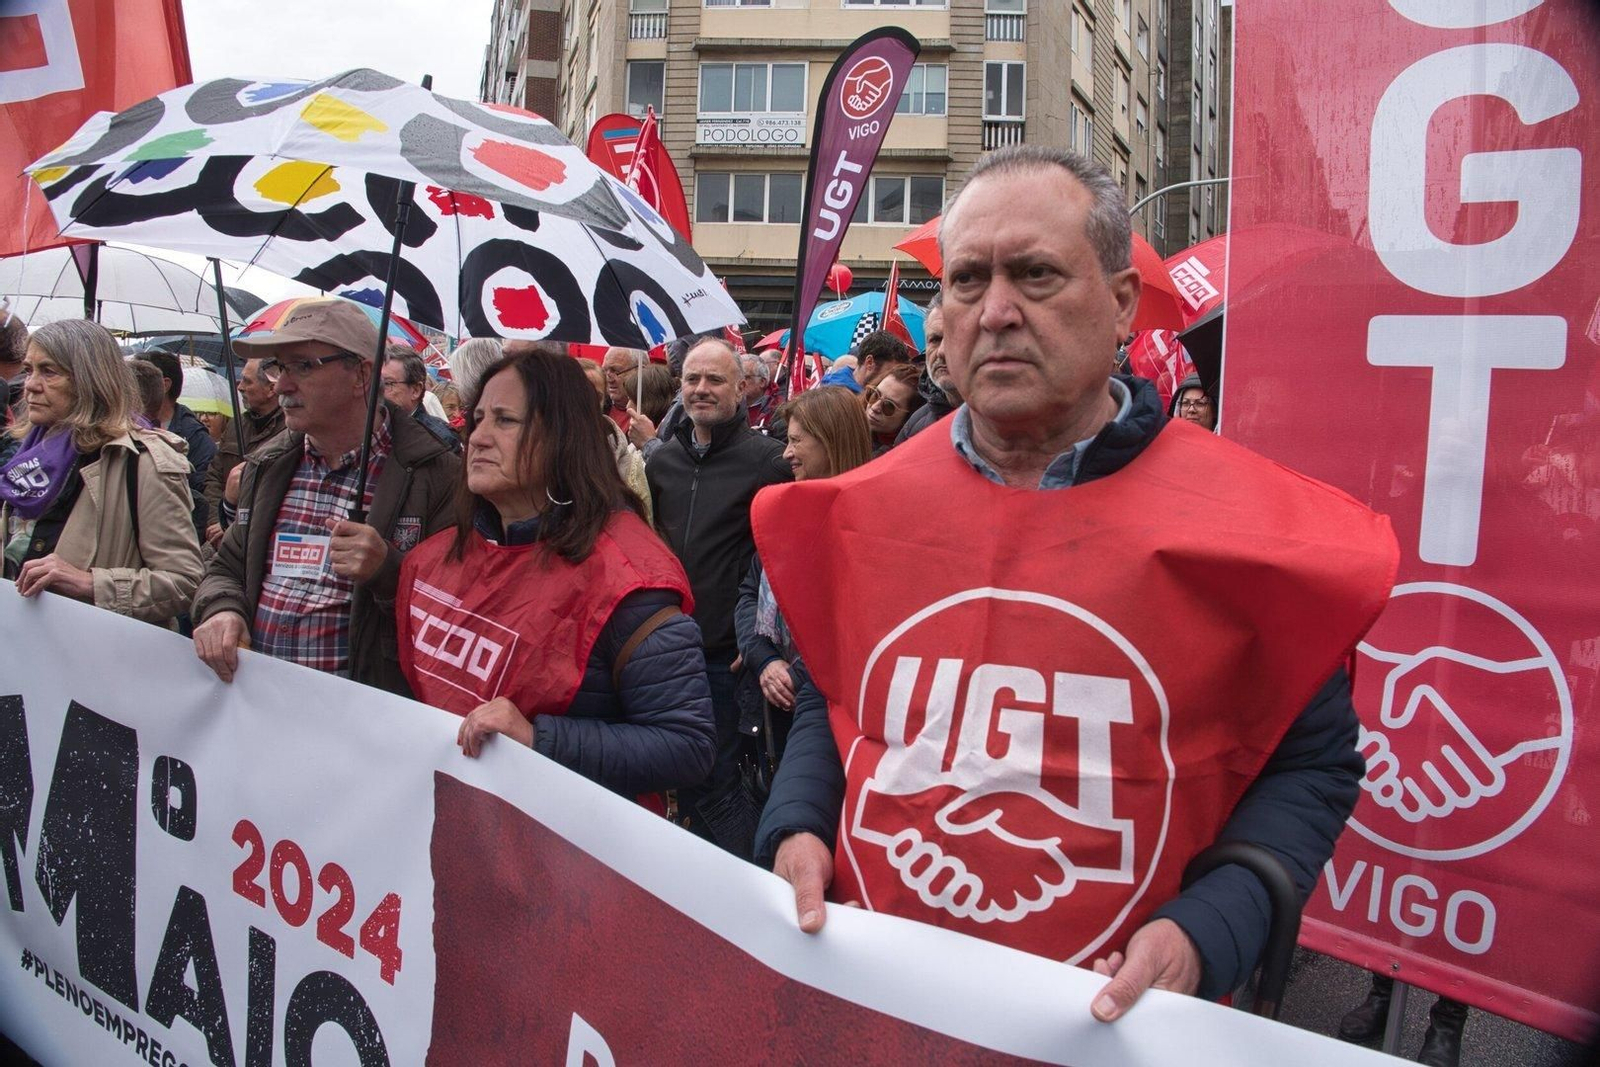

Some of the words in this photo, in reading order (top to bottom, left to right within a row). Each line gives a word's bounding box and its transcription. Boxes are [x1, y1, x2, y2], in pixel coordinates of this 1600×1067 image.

[703, 128, 798, 142] PODOLOGO
[848, 120, 880, 140] VIGO
[813, 150, 863, 241] UGT
[1367, 0, 1582, 567] GT
[279, 545, 321, 561] CCOO
[874, 655, 1134, 823] UGT
[231, 819, 403, 987] 2024
[1324, 858, 1497, 955] VIGO
[20, 947, 191, 1067] #PLENOEMPREG
